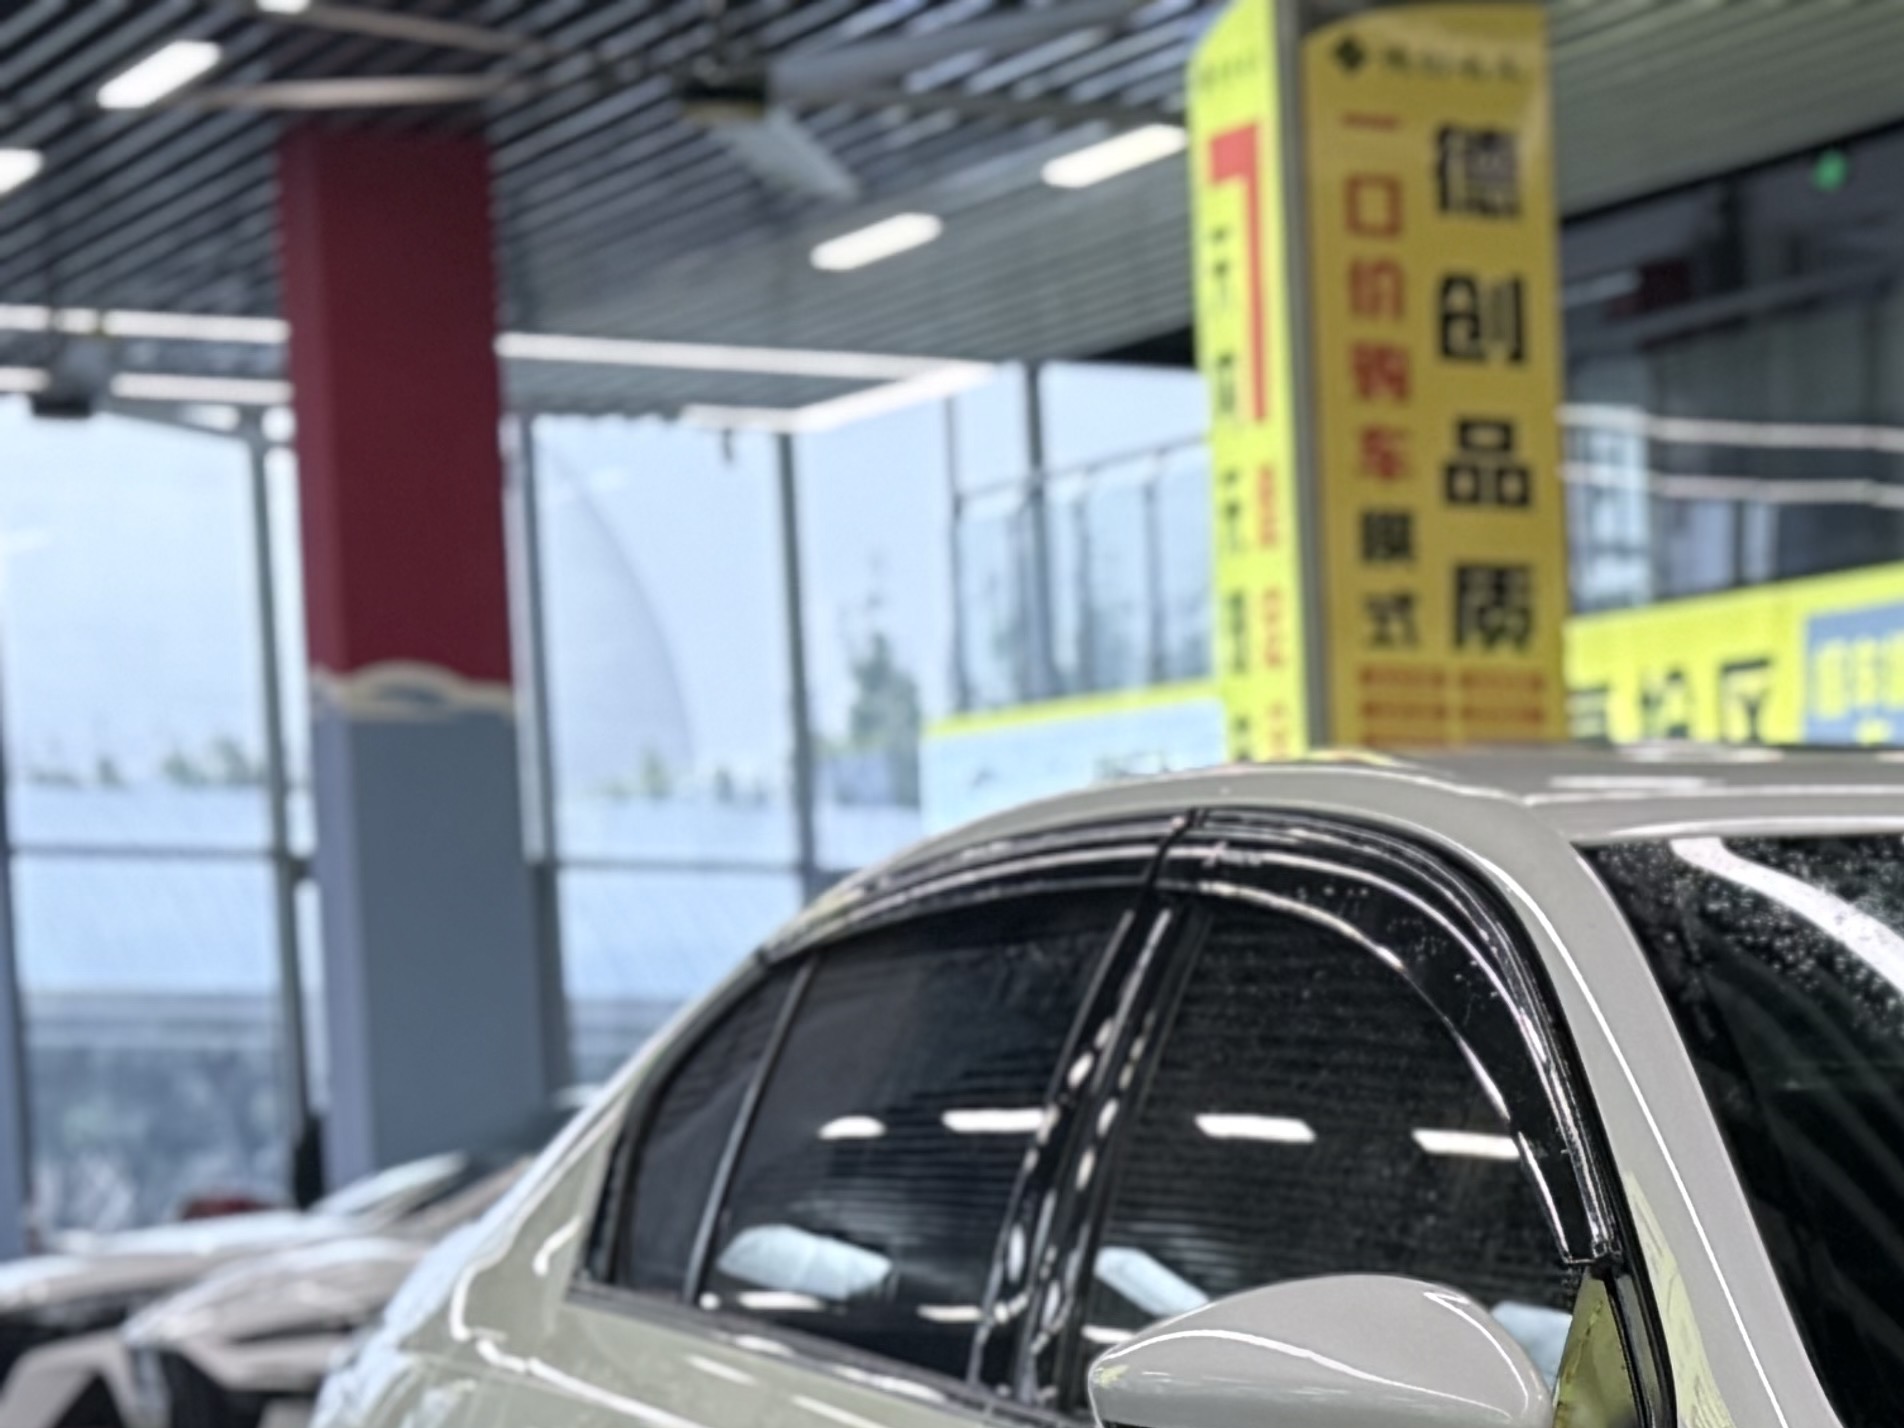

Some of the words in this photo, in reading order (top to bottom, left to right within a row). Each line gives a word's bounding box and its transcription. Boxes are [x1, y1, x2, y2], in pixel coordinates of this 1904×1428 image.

[1341, 113, 1419, 648] 一口价购车模式
[1432, 122, 1534, 653] 德创品质
